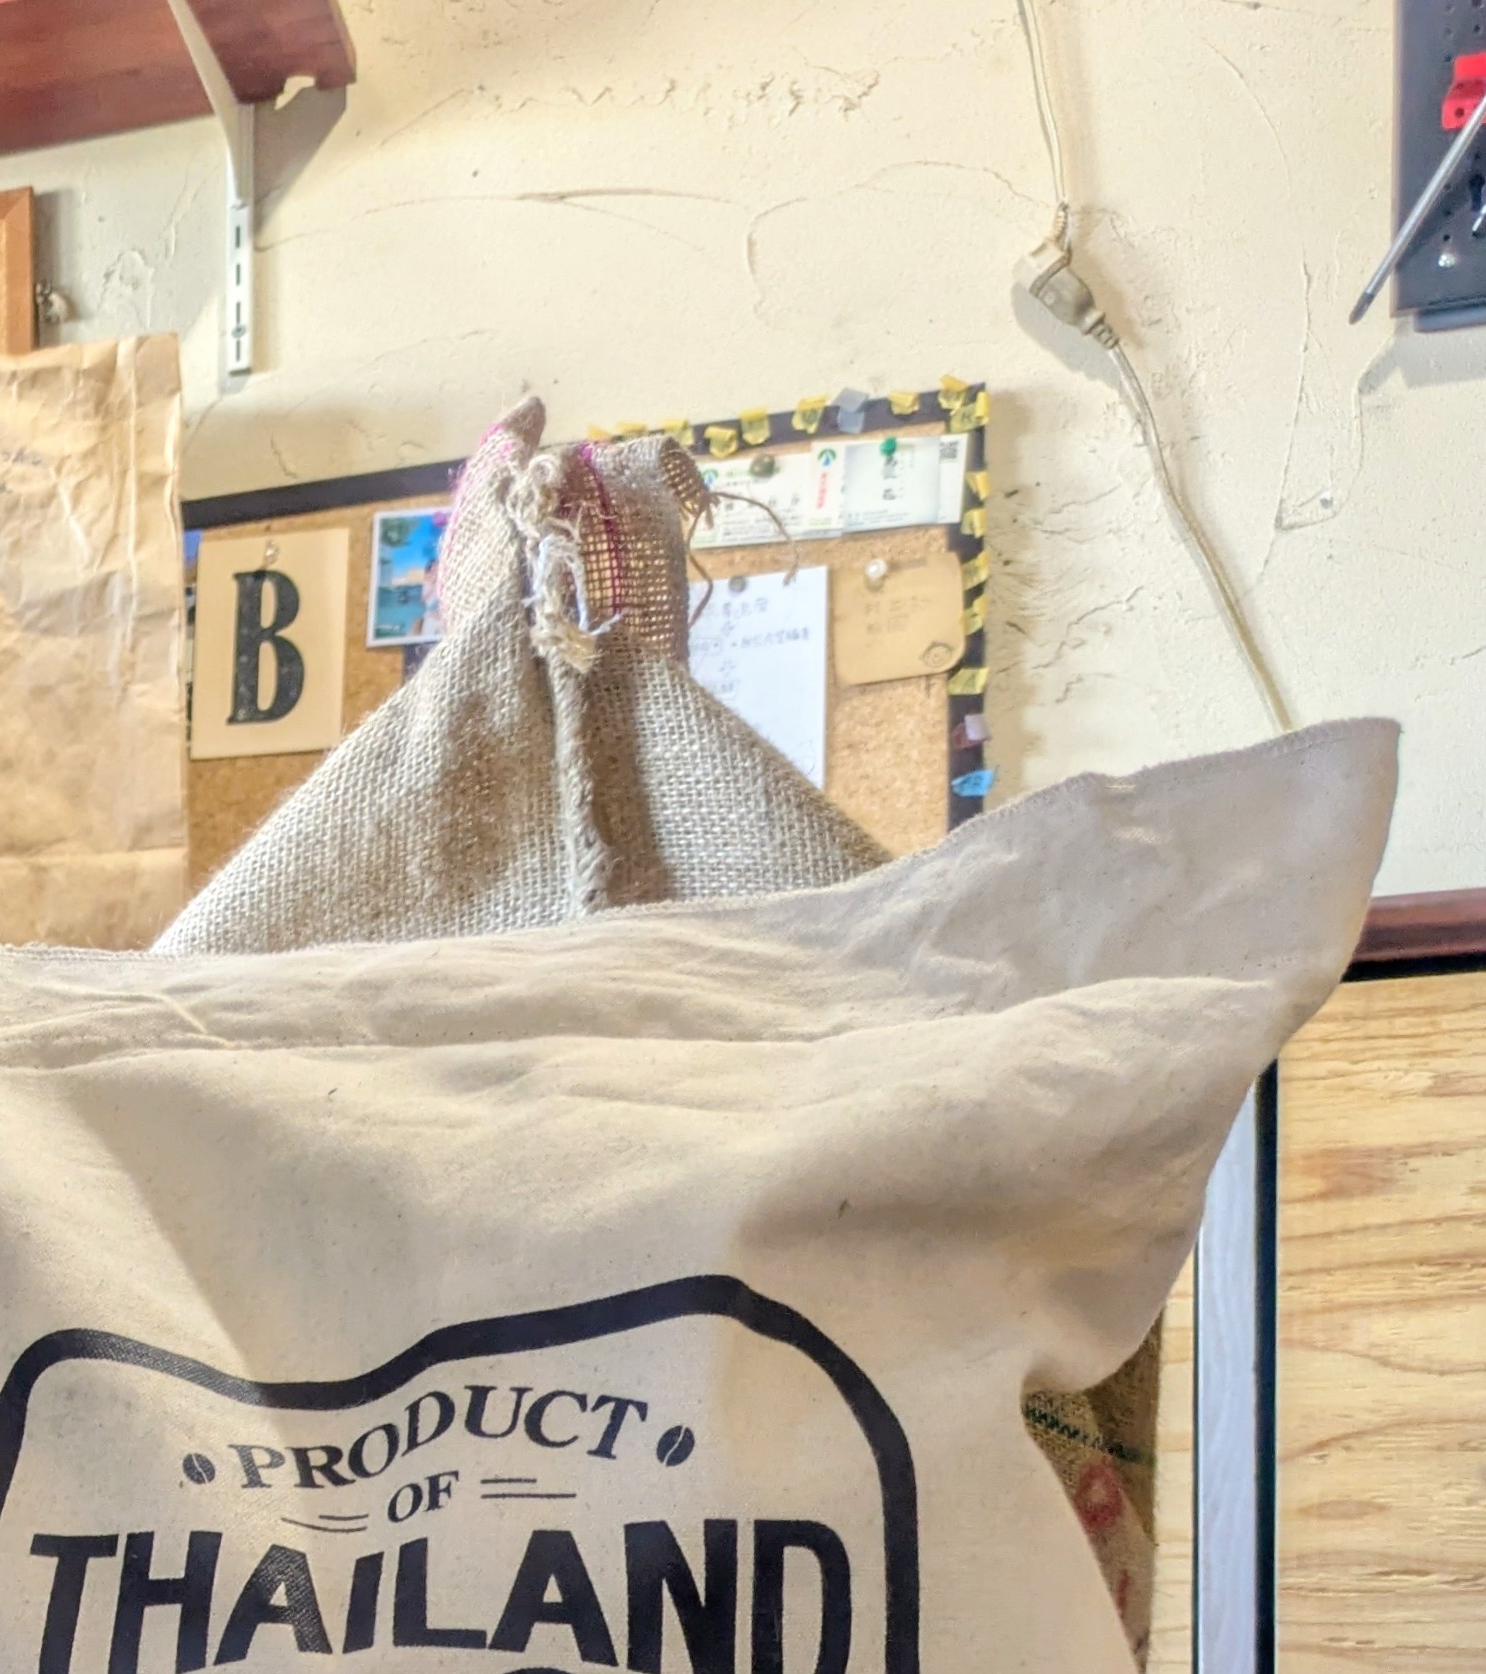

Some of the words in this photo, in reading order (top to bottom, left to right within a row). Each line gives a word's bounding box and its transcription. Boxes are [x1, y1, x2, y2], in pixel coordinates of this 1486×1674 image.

[226, 569, 306, 726] B
[238, 1384, 649, 1491] PRODUCT
[386, 1469, 461, 1524] OF
